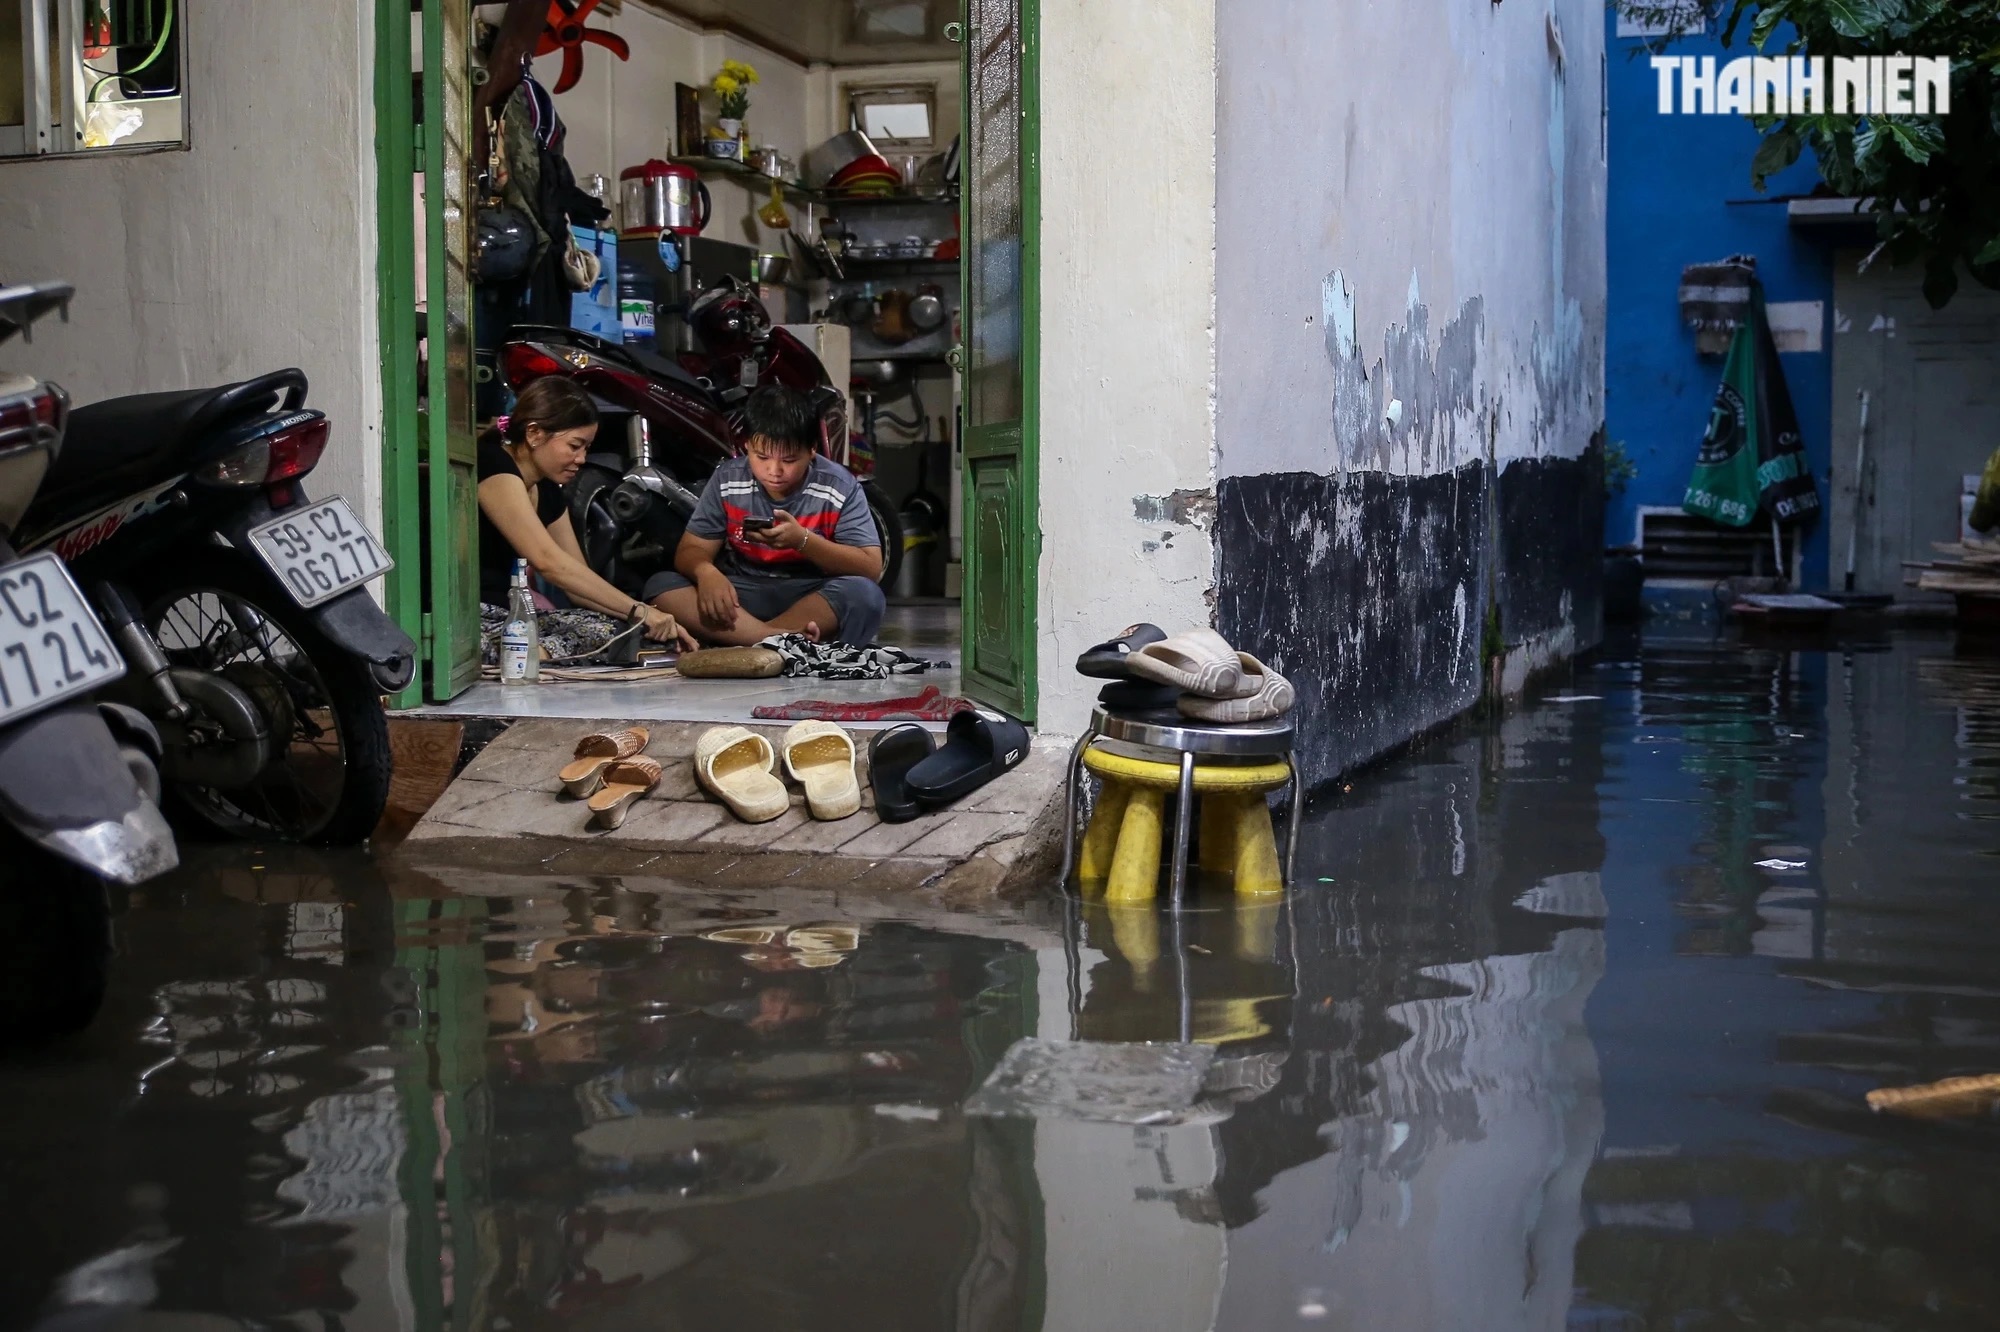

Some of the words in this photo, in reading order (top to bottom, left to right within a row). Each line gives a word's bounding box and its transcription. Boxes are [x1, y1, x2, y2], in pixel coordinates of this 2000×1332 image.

[281, 412, 316, 428] HONDA
[267, 507, 352, 559] 59-C2
[287, 535, 379, 599] 062.77
[0, 570, 64, 628] C2
